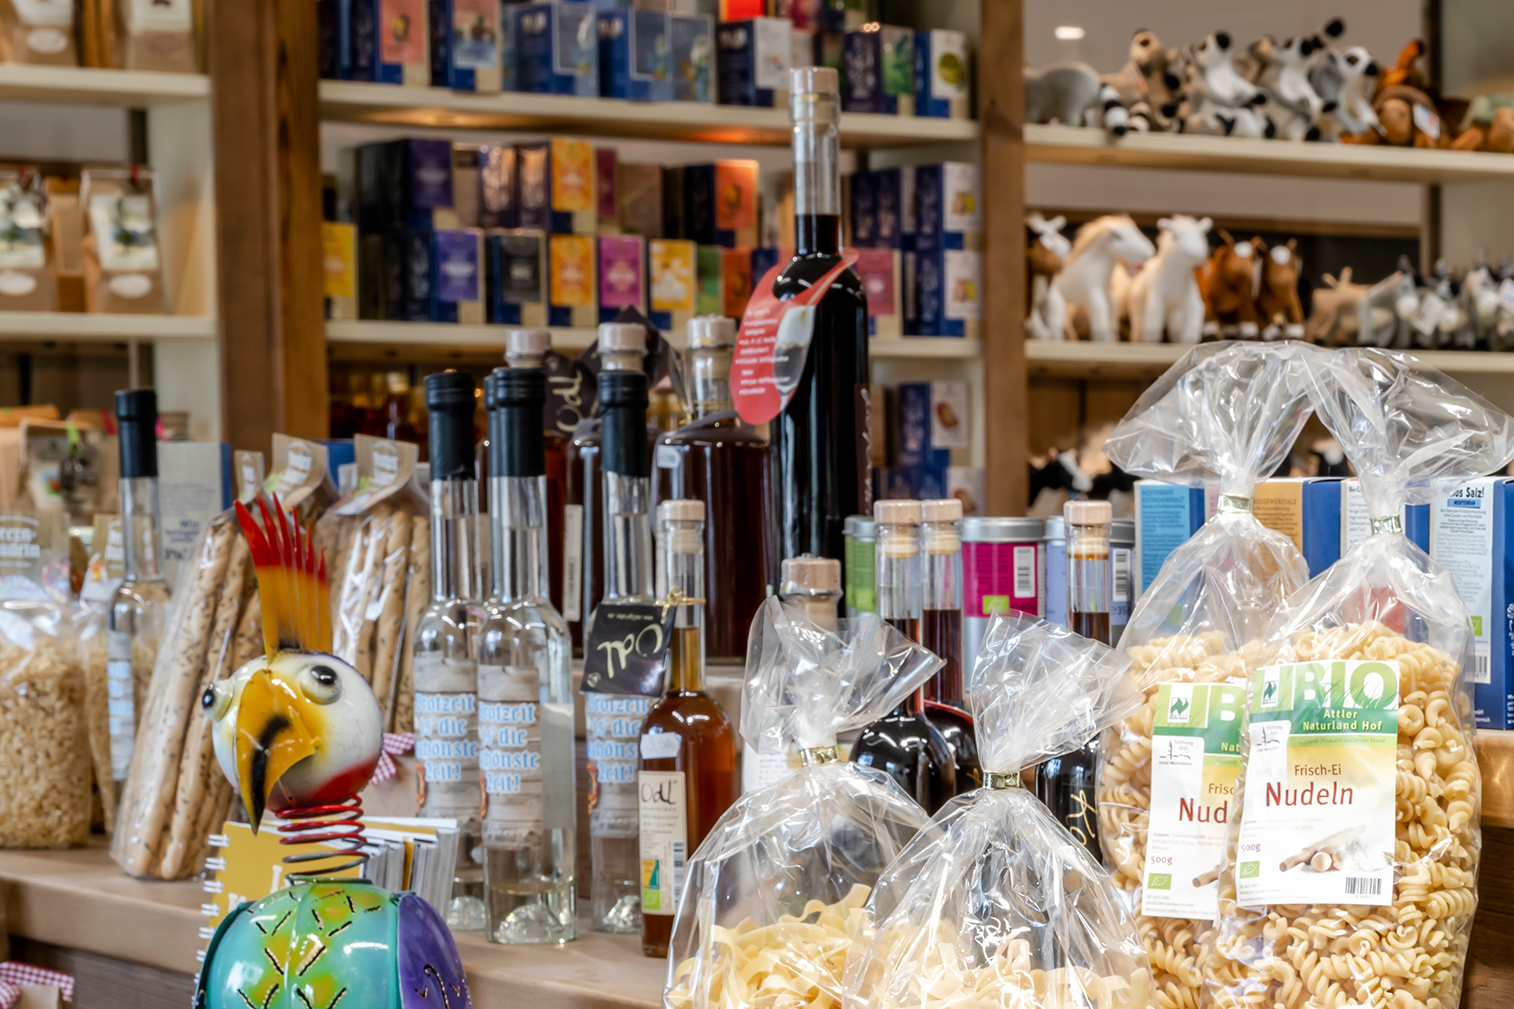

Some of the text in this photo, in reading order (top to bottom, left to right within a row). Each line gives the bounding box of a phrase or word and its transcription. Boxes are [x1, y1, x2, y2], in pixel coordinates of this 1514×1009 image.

[1466, 487, 1485, 499] Salz!
[1294, 662, 1398, 709] BIO
[1323, 709, 1358, 719] Attler
[438, 717, 466, 735] die
[1302, 721, 1383, 731] Naturland Hof
[499, 726, 527, 745] die
[1294, 763, 1342, 776] Frisch-Ei
[1265, 781, 1354, 807] Nudeln
[1241, 843, 1261, 854] 500g
[1150, 855, 1173, 866] 500g
